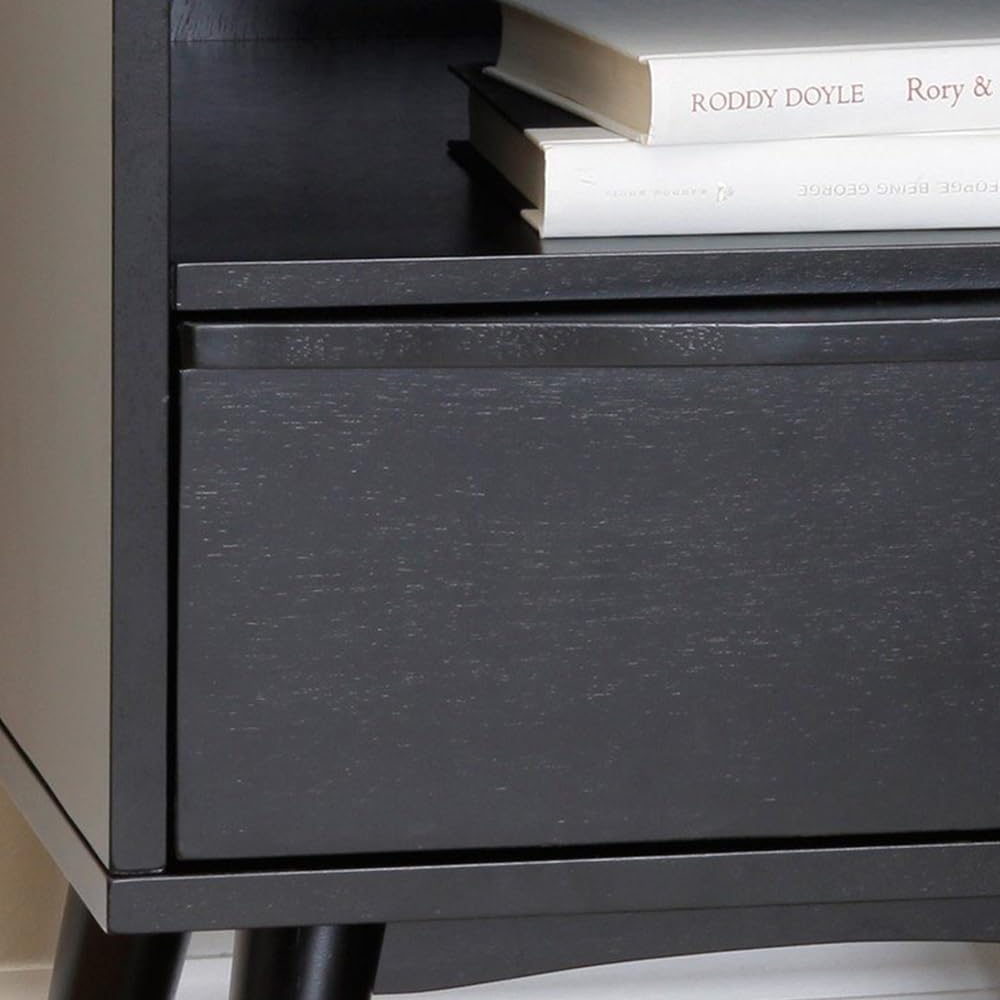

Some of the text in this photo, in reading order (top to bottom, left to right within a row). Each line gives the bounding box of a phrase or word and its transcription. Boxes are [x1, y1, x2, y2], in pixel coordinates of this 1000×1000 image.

[691, 83, 865, 113] RODDY DOYLE
[906, 77, 965, 108] Rory
[972, 75, 993, 97] &
[876, 182, 929, 196] BEING
